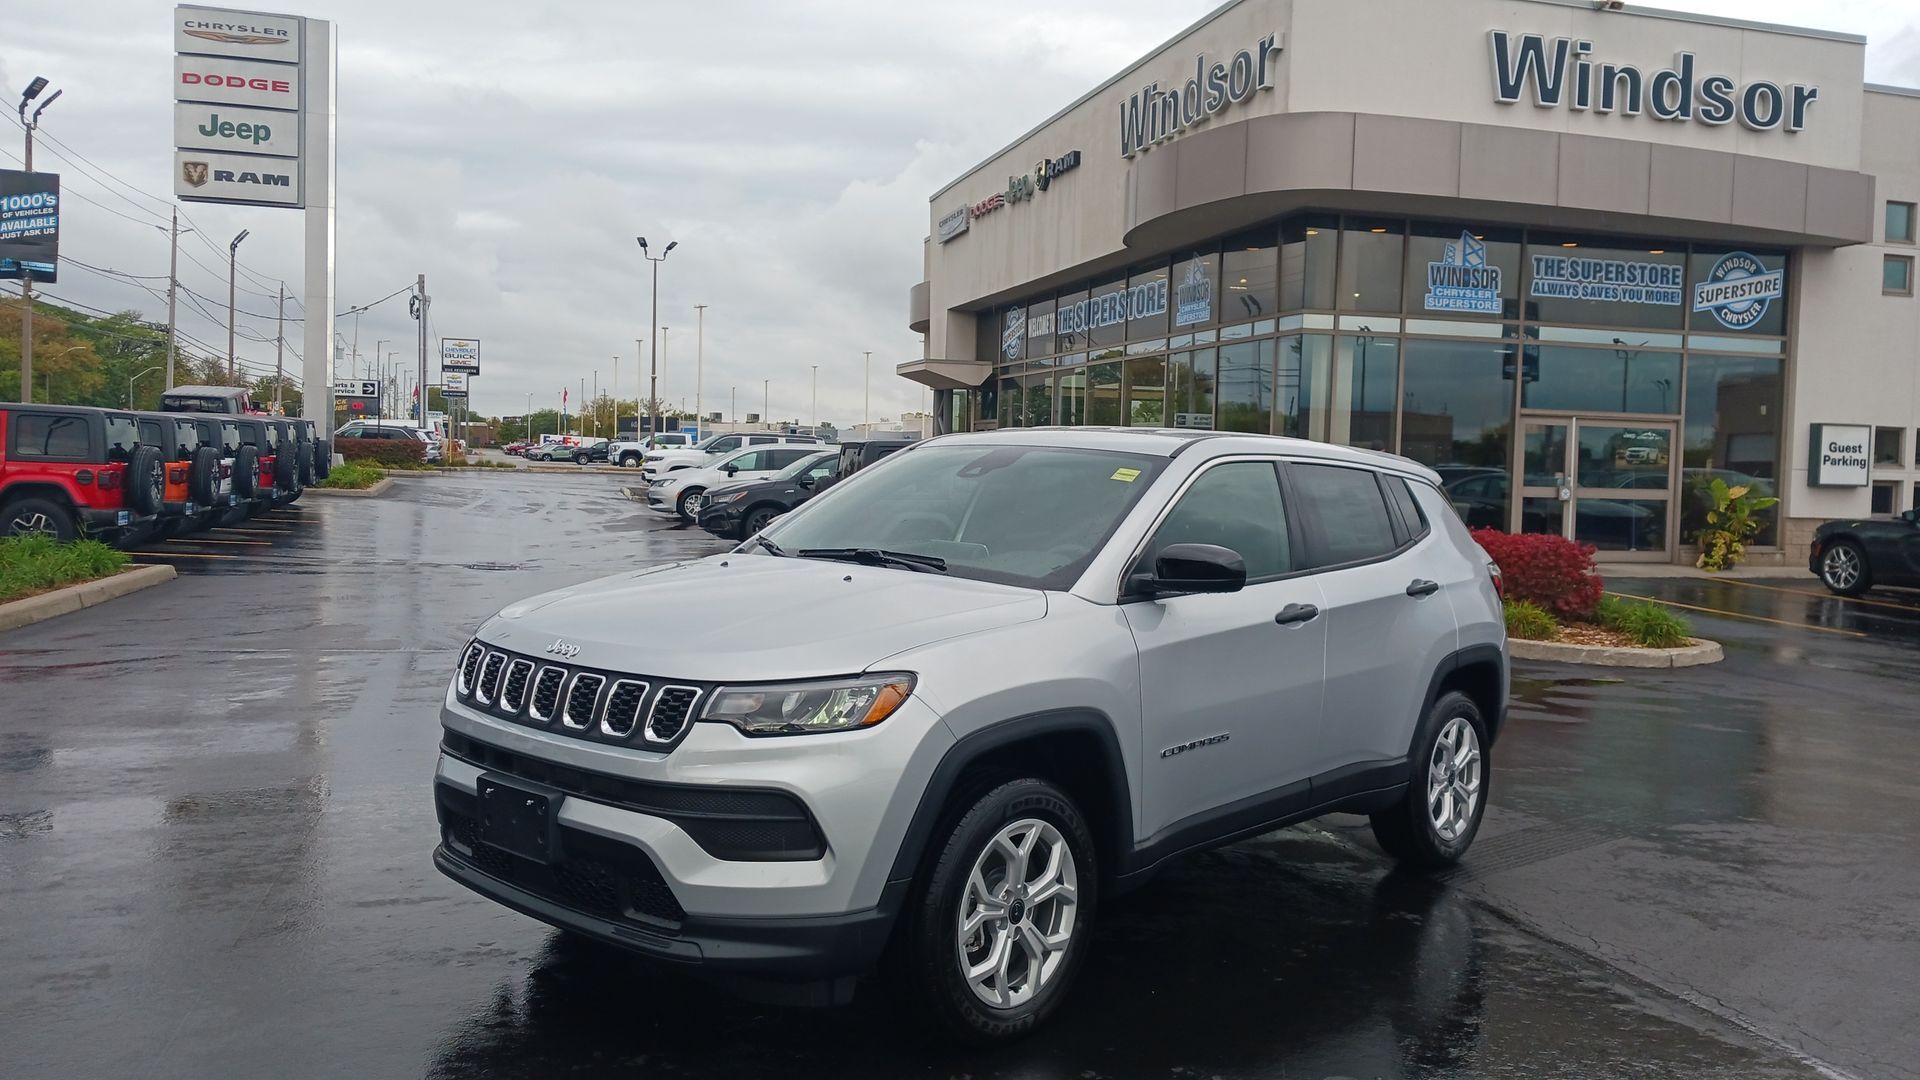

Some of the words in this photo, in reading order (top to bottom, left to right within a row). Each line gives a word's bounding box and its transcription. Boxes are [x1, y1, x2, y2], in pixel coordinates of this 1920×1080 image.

[184, 20, 289, 37] CHRYSLER
[182, 72, 290, 93] DODGE
[1488, 29, 1820, 132] Windsor
[1119, 31, 1280, 160] Windsor
[198, 113, 272, 145] Jeep
[1046, 150, 1080, 178] RAM
[213, 169, 290, 187] RAM
[0, 193, 57, 210] 1000's
[15, 207, 54, 217] VEHICLES
[970, 193, 1004, 219] DODGE
[0, 231, 21, 240] JUST
[23, 229, 42, 237] ASK
[43, 227, 56, 235] US
[1, 217, 56, 231] AVAILABLE
[1431, 265, 1499, 290] WINDSOR
[1533, 256, 1566, 278] THE
[1568, 257, 1682, 286] SUPERSTORE
[1715, 257, 1757, 279] WINDSOR
[1436, 287, 1492, 299] CHRYSLER
[1532, 281, 1580, 297] ALWAYS
[1581, 283, 1619, 300] SAVES
[1621, 287, 1643, 301] YOU
[1644, 289, 1681, 304] MORE!
[1698, 278, 1780, 304] SUPERSTORE
[1058, 306, 1073, 334] THE
[1074, 279, 1168, 332] SUPERSTORE
[1428, 297, 1500, 310] SUPERSTORE
[1721, 302, 1762, 325] CHRYSLER
[1828, 441, 1863, 454] Guest
[1823, 455, 1867, 469] Parking
[545, 639, 581, 659] Jeep
[1160, 732, 1230, 759] COMPASS
